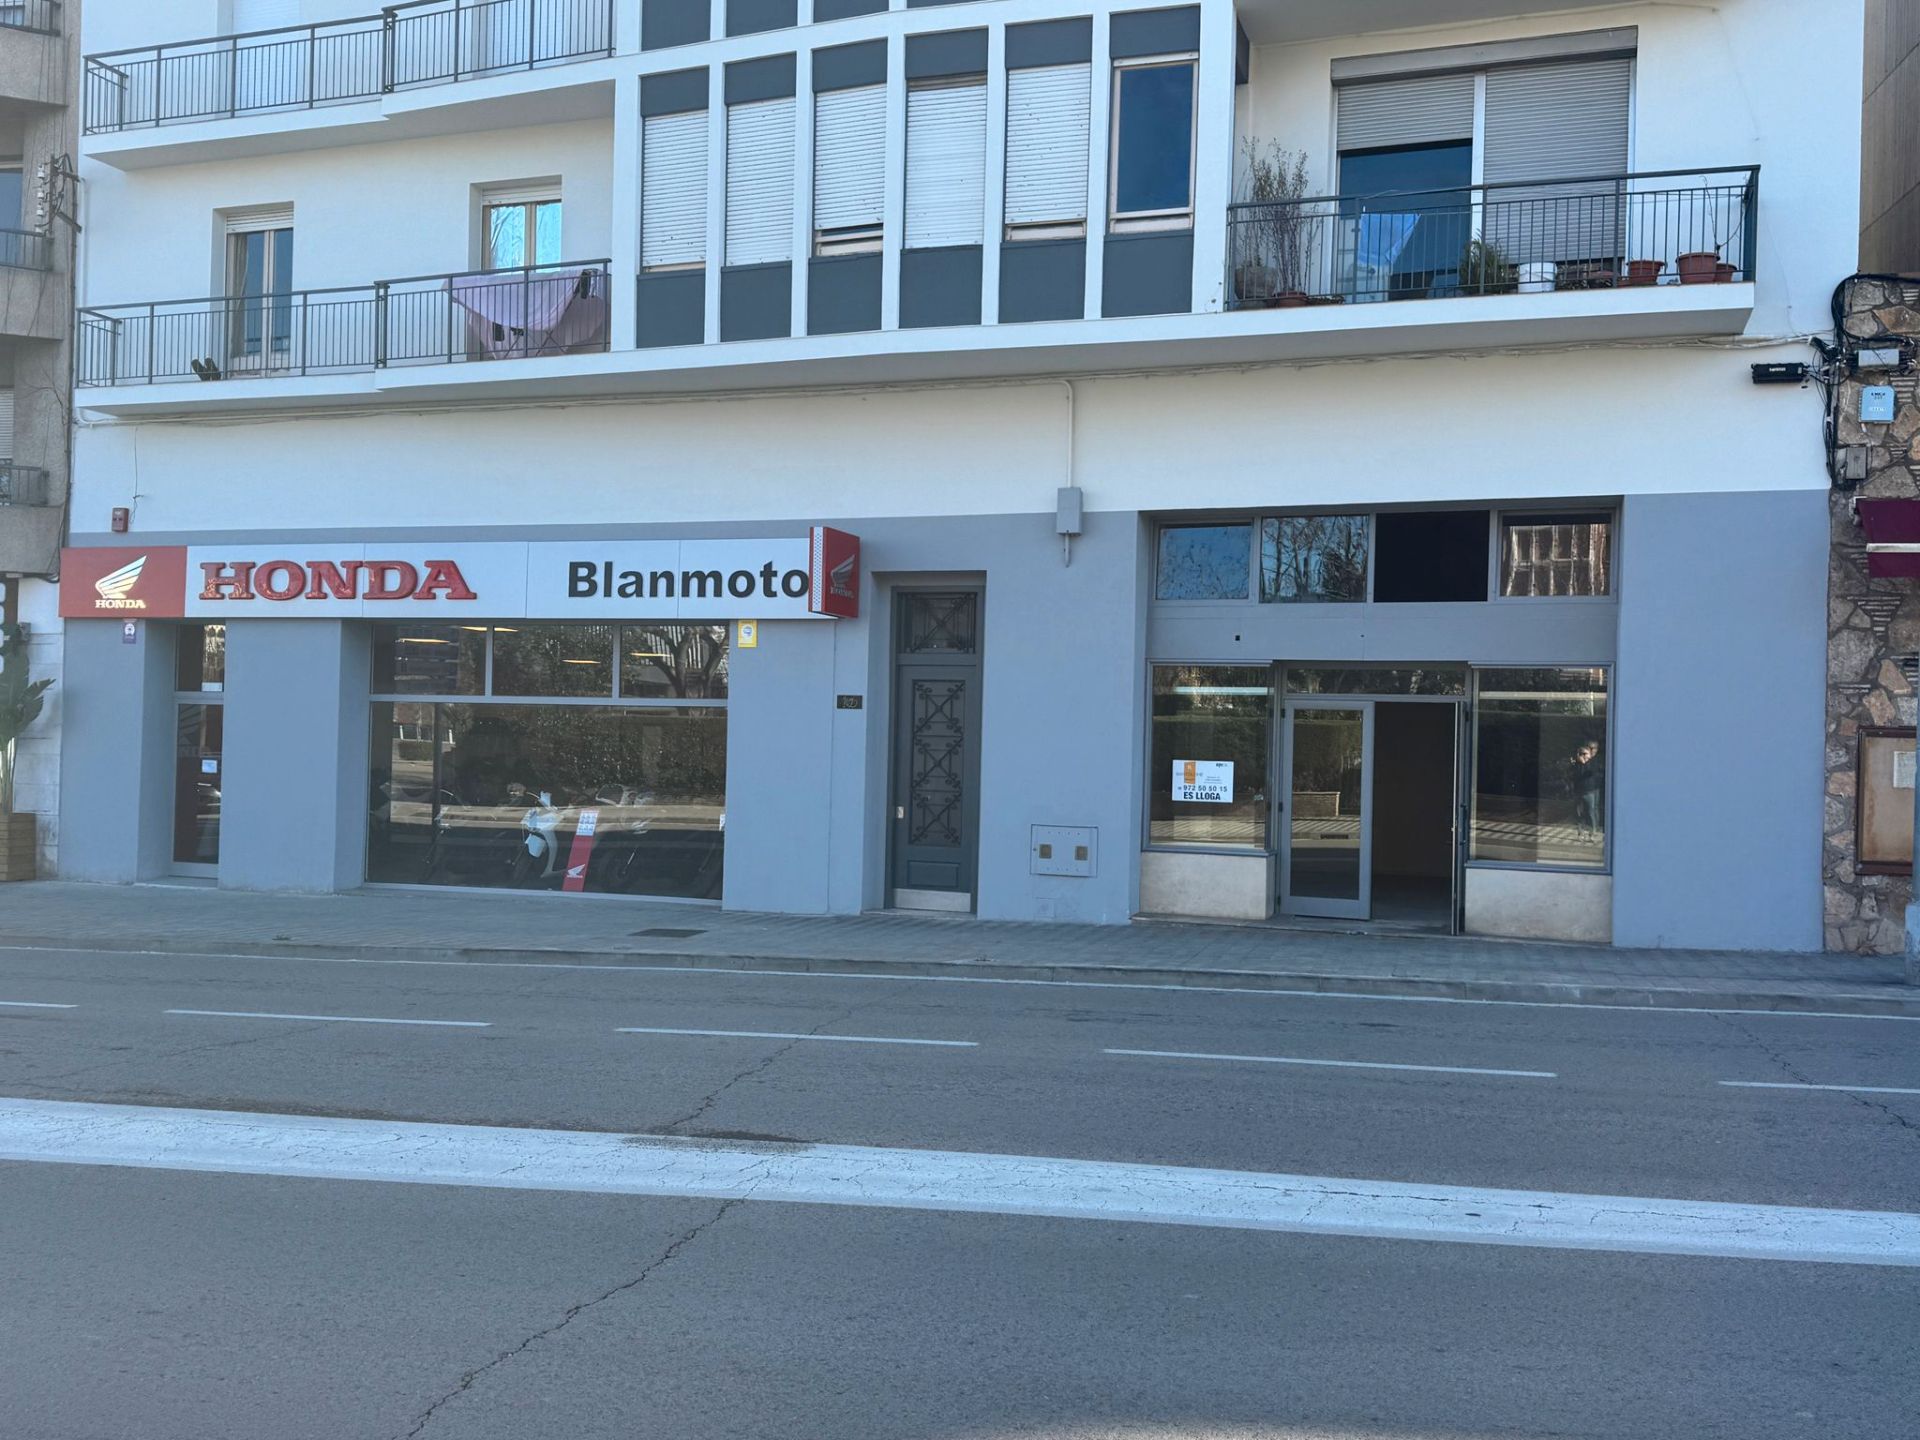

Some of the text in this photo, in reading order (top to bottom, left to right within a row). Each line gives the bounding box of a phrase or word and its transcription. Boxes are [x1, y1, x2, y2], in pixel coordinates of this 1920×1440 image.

[199, 560, 809, 601] HONDA Blanmoto
[95, 599, 147, 609] HONDA
[1196, 792, 1220, 800] LLOGA
